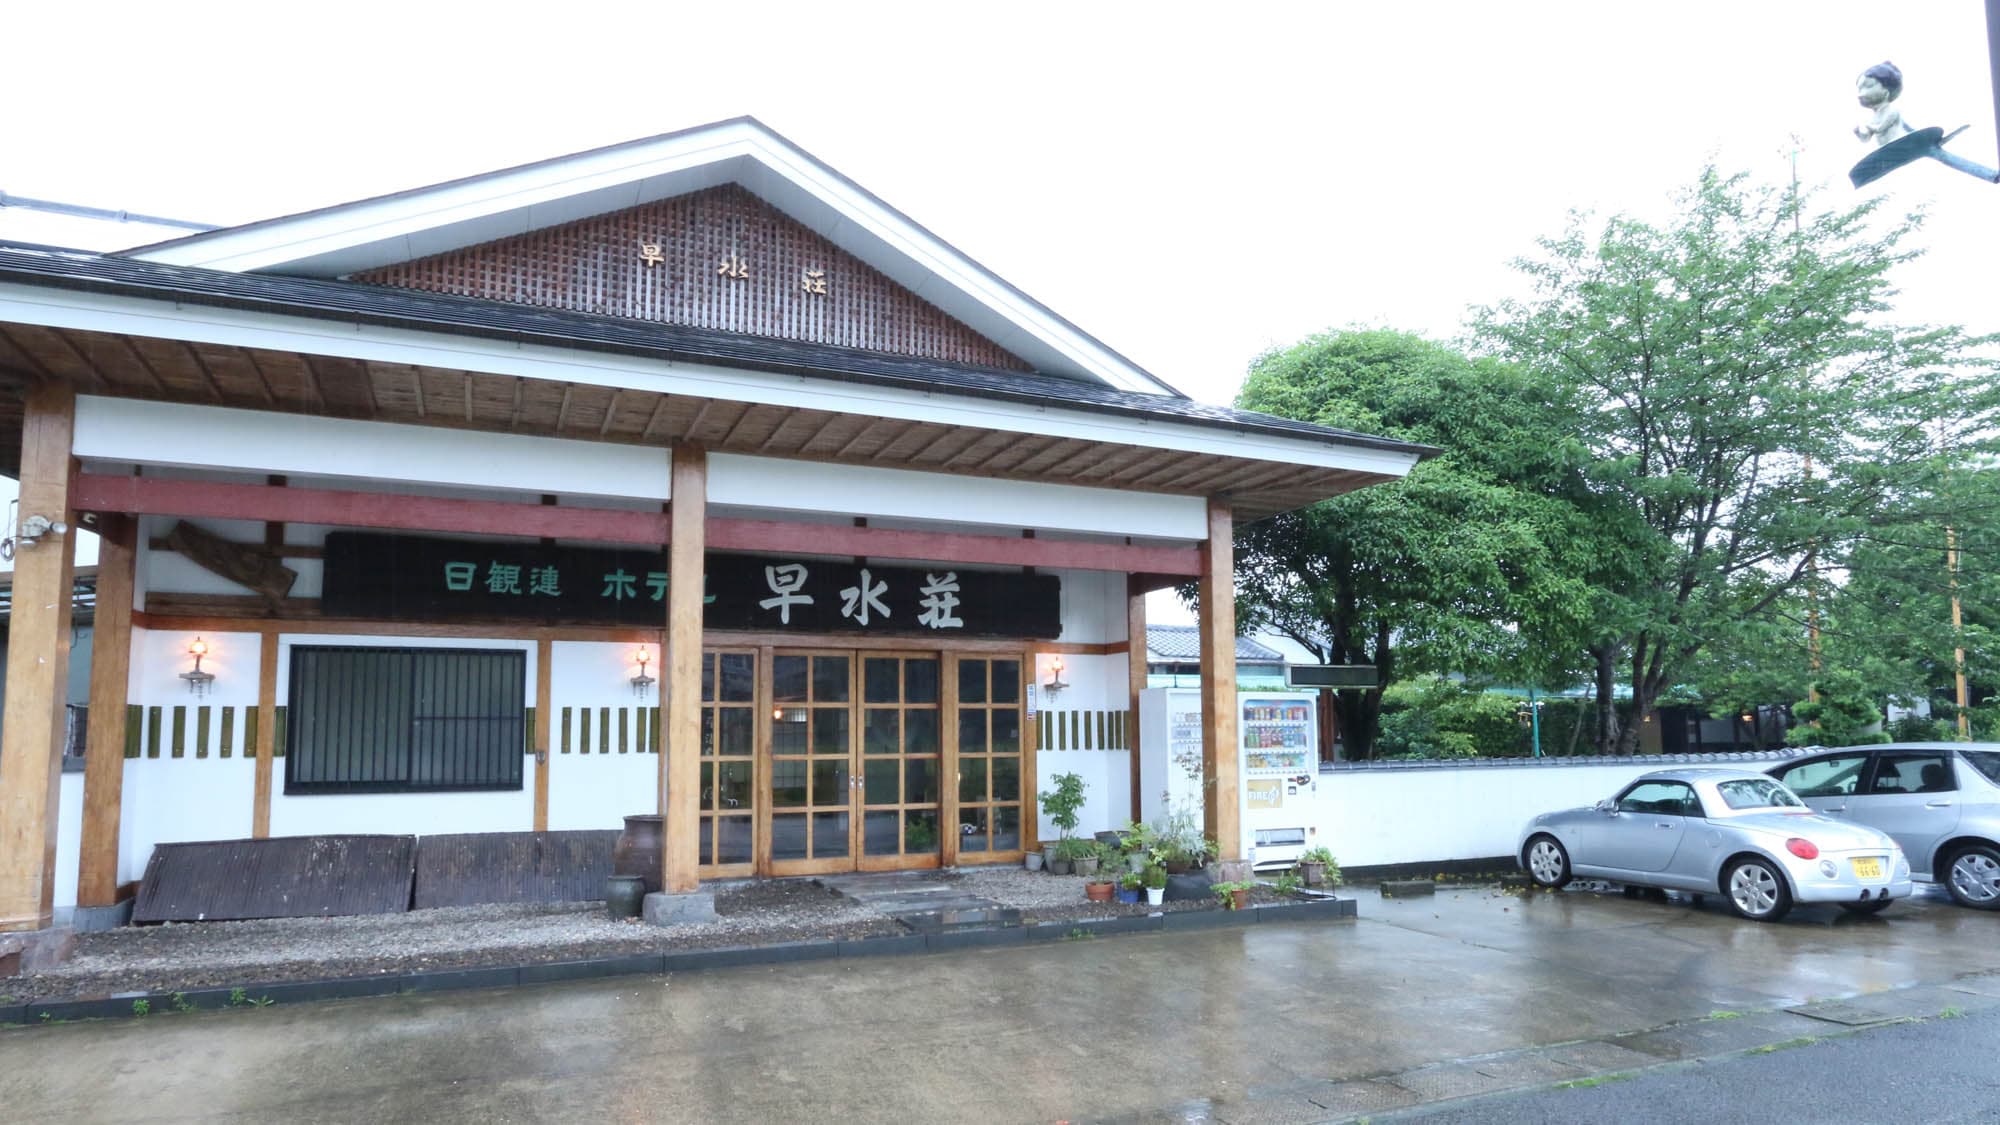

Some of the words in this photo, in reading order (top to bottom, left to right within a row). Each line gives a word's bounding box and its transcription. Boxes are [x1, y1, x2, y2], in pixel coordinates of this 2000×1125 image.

[640, 243, 827, 295] 早水荘
[445, 560, 562, 597] 日観連
[759, 563, 964, 629] 早水荘
